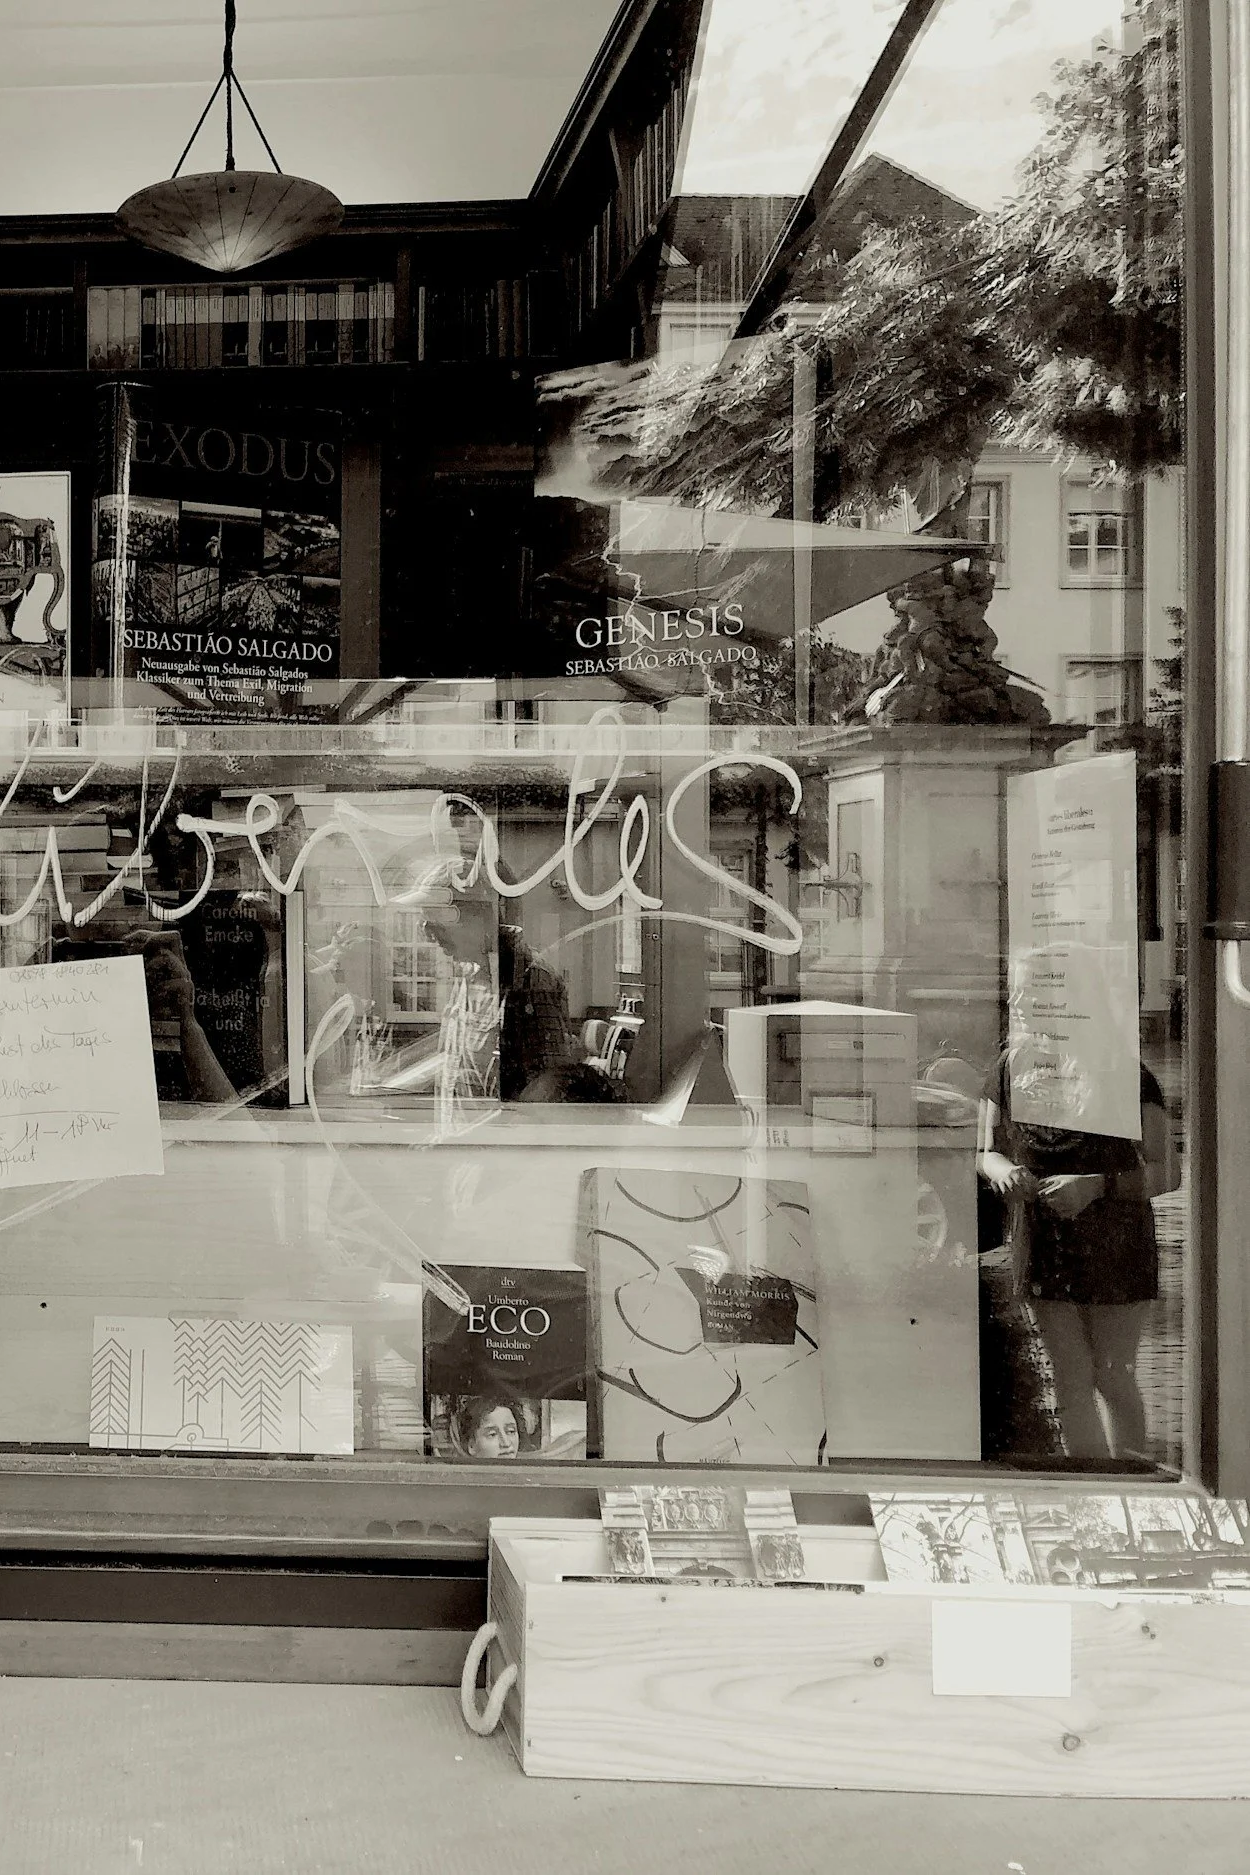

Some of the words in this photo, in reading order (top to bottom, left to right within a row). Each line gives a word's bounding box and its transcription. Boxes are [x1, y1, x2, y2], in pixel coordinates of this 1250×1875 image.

[130, 417, 336, 486] EXODUS
[575, 603, 745, 648] GENESIS
[123, 629, 232, 655] SEBASTIÃO
[237, 638, 333, 662] SALGADO
[142, 657, 200, 674] Neuausgabe
[203, 664, 220, 673] von
[222, 665, 266, 678] Sebastião
[268, 668, 309, 681] Salgados
[565, 652, 659, 676] SEBASTIÃO
[667, 645, 758, 668] SALGADO
[136, 671, 181, 686] Klassiker
[182, 677, 204, 687] zum
[206, 676, 240, 689] Thema
[242, 678, 265, 691] Exil,
[267, 682, 313, 695] Migration
[187, 690, 206, 700] und
[209, 690, 265, 707] Vertreibung
[215, 1013, 244, 1031] und
[488, 1294, 529, 1306] Umberto
[751, 1290, 790, 1300] MORRIS
[466, 1304, 551, 1336] ECO
[485, 1338, 531, 1350] Baudolino
[492, 1350, 525, 1361] Roman
